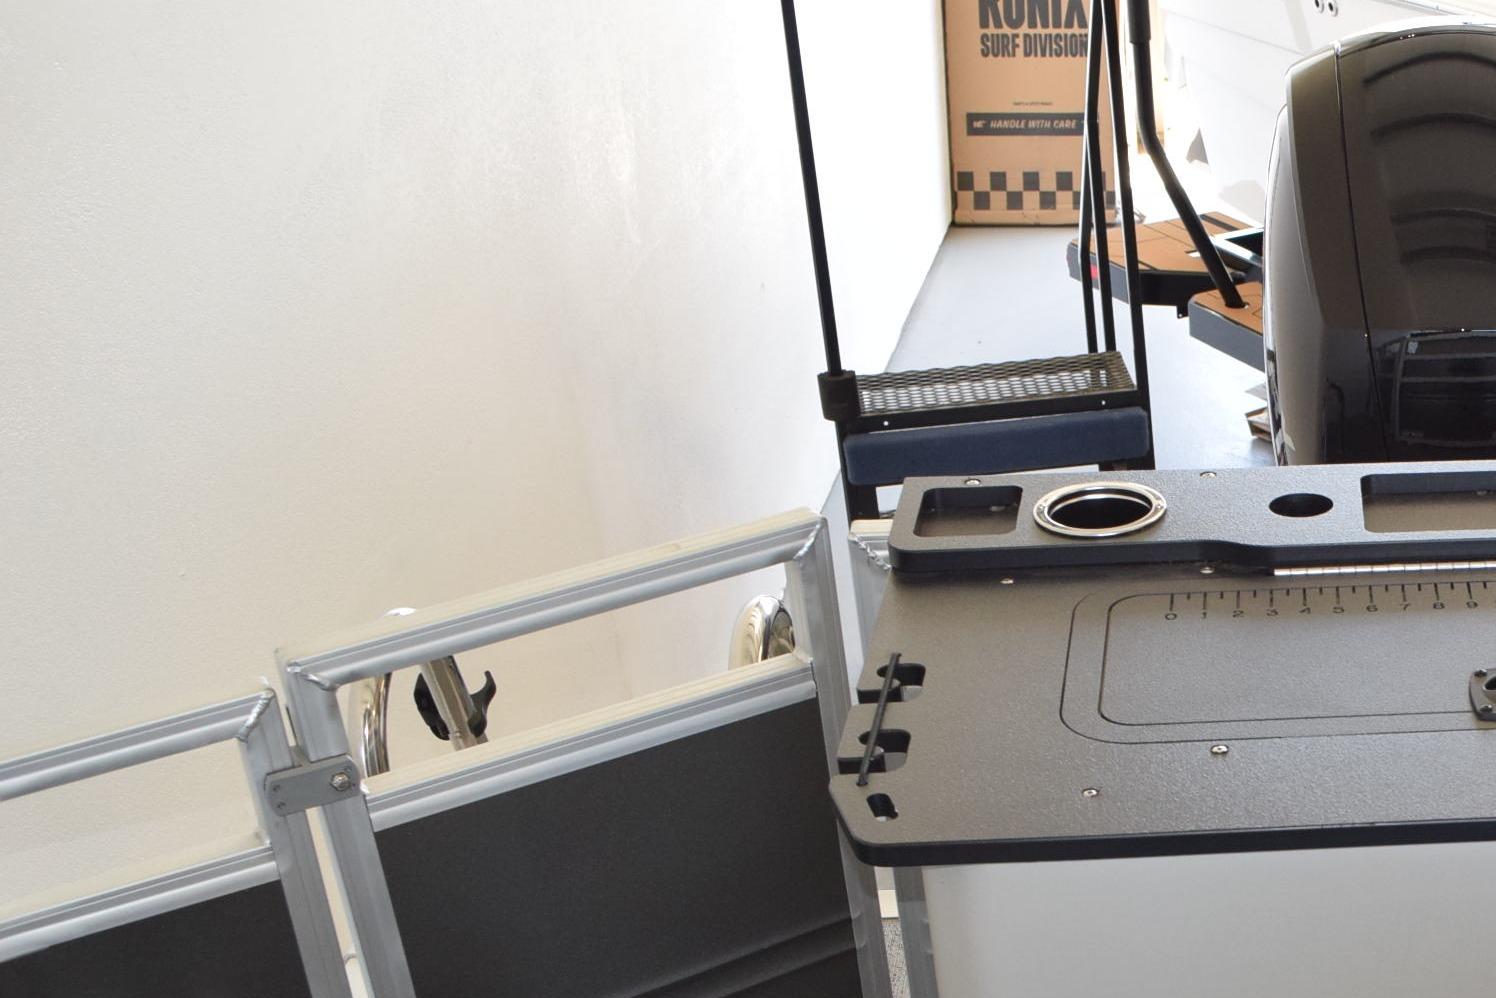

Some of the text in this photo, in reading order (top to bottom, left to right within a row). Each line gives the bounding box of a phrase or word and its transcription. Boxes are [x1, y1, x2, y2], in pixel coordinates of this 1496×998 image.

[980, 32, 1088, 58] SURF DIVISION
[990, 120, 1077, 129] HANDLE WITH CARE
[1365, 604, 1378, 613] 6
[1432, 601, 1445, 610] 8
